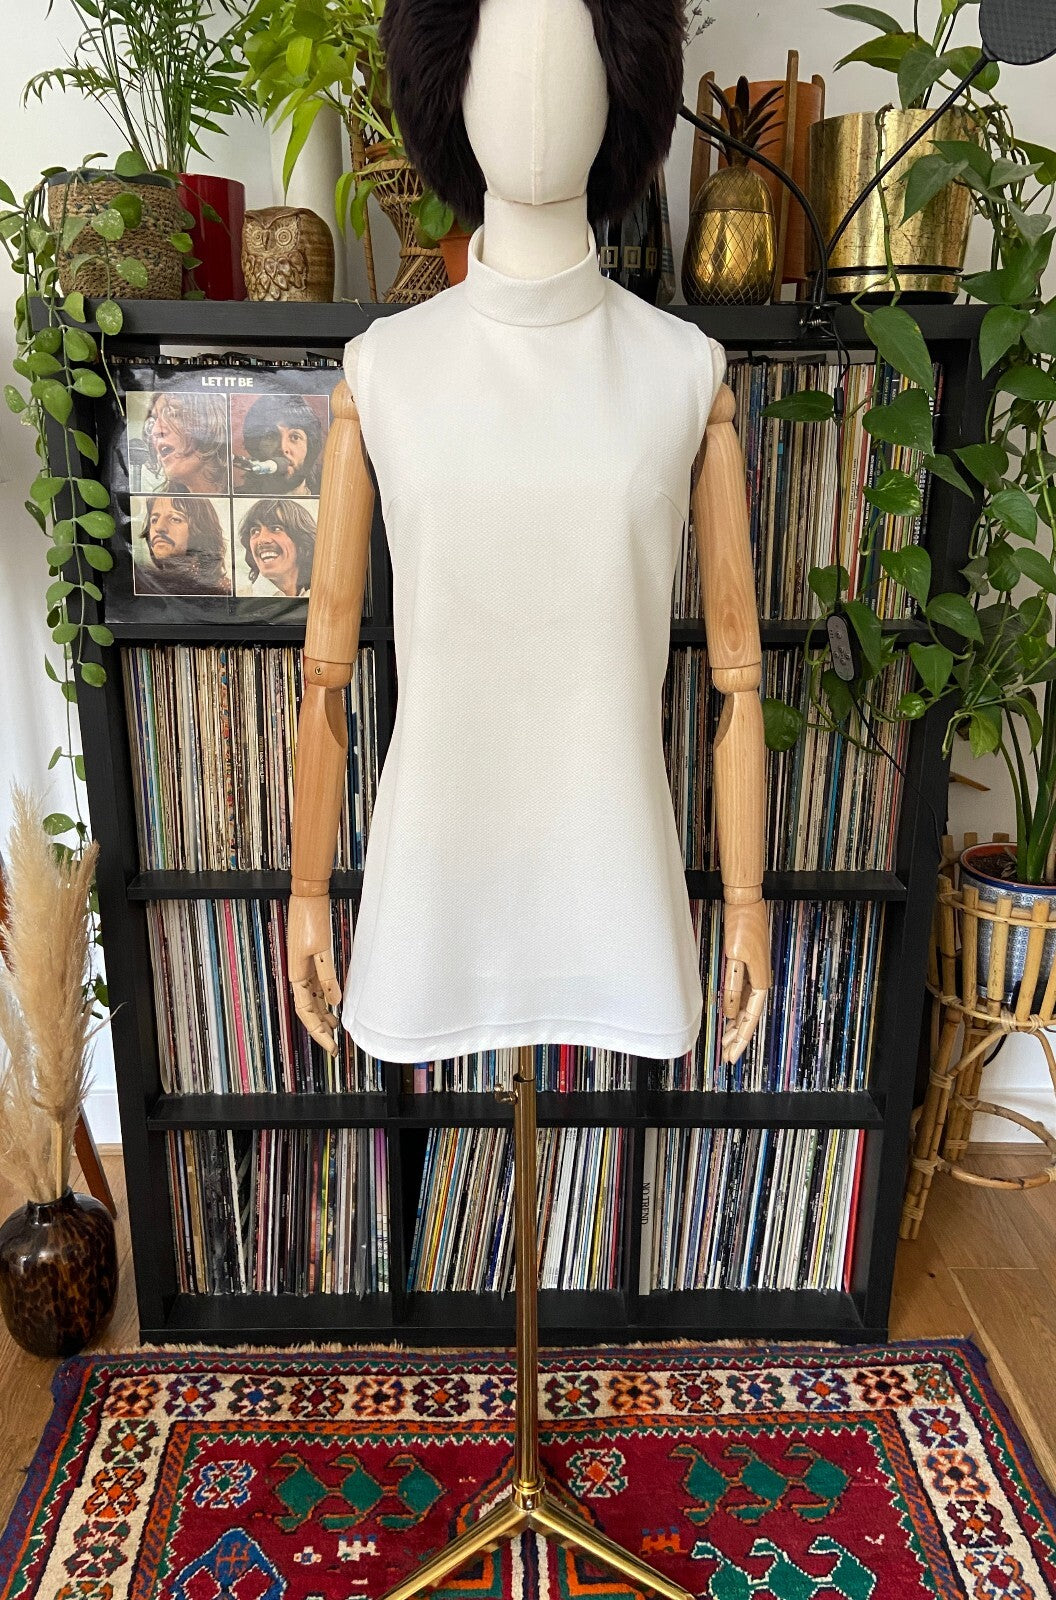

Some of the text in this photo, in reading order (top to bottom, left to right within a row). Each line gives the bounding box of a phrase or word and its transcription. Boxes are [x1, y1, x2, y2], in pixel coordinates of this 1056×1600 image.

[202, 377, 253, 387] LET IT BE
[641, 1182, 650, 1225] NO TREND
